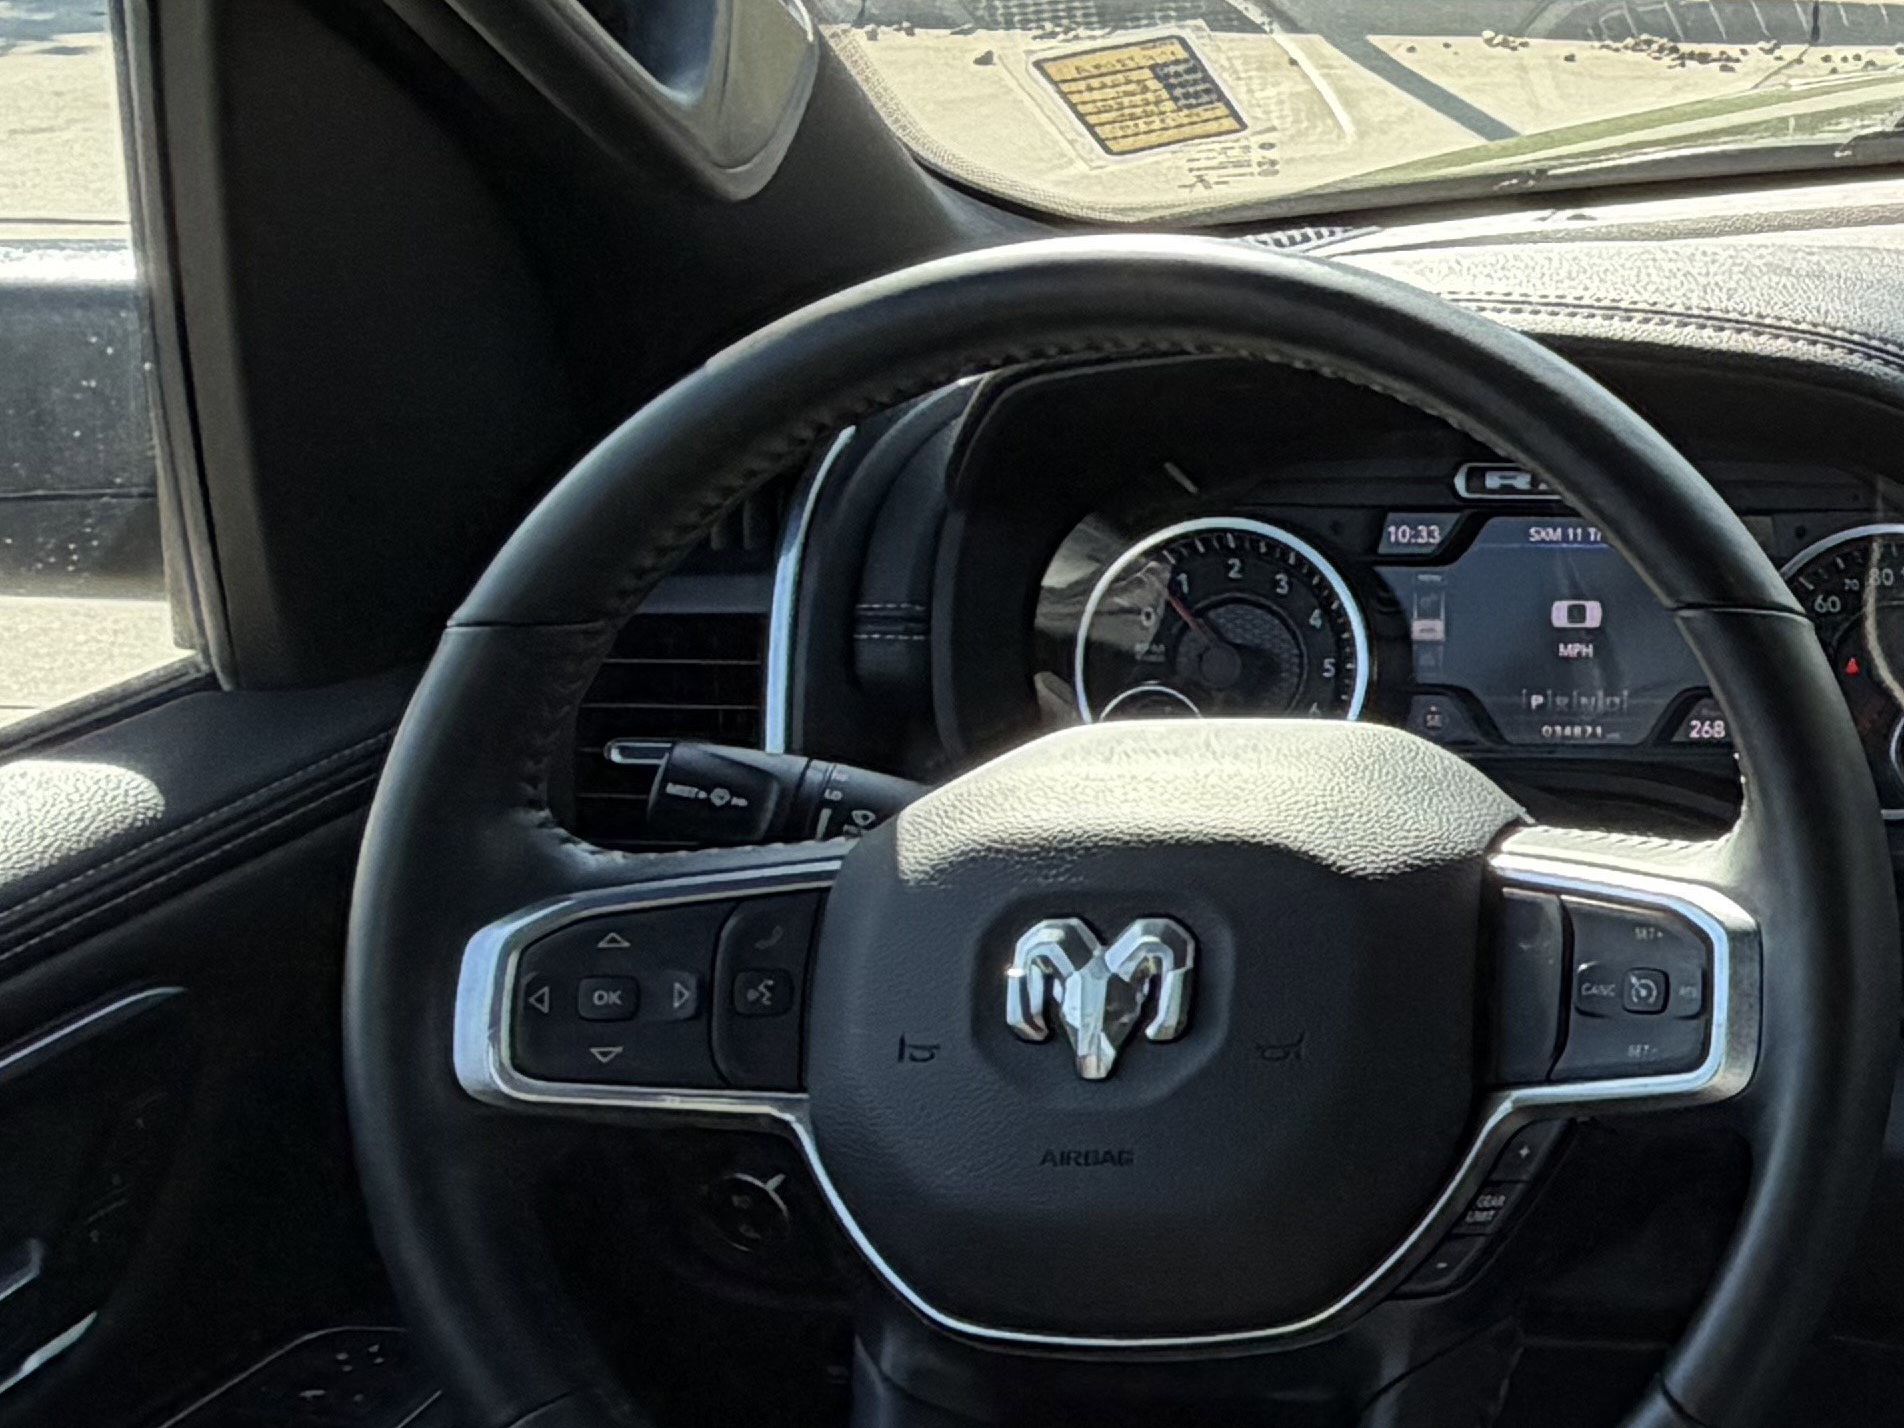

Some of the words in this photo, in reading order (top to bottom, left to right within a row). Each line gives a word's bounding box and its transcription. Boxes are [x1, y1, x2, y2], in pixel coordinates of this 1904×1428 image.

[1388, 525, 1440, 543] 10:33
[1529, 527, 1562, 542] SXM
[1567, 527, 1583, 542] 11
[1228, 558, 1243, 579] 2
[1869, 568, 1893, 585] 80
[1177, 574, 1189, 594] 1
[1275, 574, 1289, 595] 3
[1814, 596, 1841, 613] 60
[1141, 608, 1155, 626] 0
[1309, 609, 1322, 628] 4
[1559, 643, 1593, 658] MPH
[1322, 658, 1336, 677] 5
[1530, 694, 1544, 710] P
[1688, 720, 1725, 739] 268
[594, 990, 621, 1006] OK
[1581, 983, 1616, 997] CANC
[1041, 1149, 1134, 1167] AIRBAG
